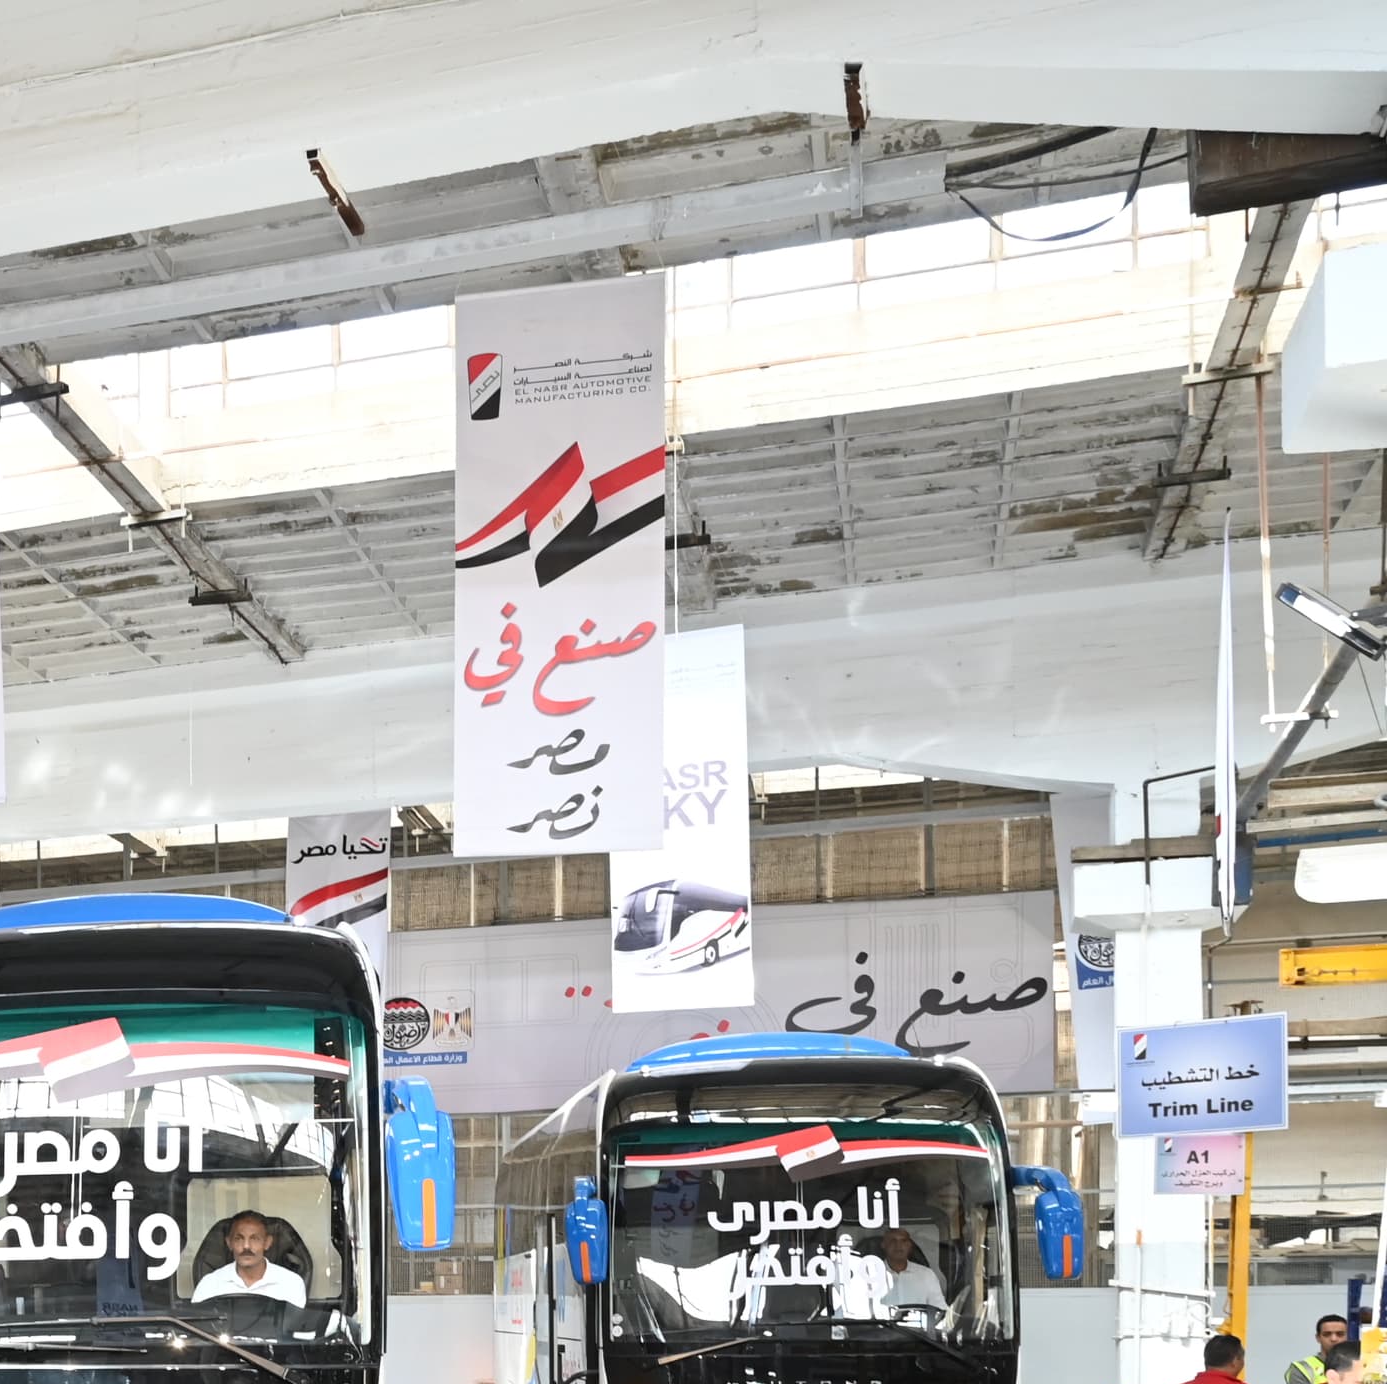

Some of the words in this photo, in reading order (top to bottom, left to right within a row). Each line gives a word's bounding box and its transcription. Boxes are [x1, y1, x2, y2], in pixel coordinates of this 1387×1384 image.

[513, 358, 572, 374] النصر
[575, 350, 653, 365] شركة
[513, 373, 572, 388] السيارات
[575, 364, 653, 380] لصناعة
[515, 387, 529, 397] EL
[534, 383, 568, 395] NASR
[573, 375, 652, 391] AUTOMOTIVE
[515, 387, 624, 406] MANUFACTURING
[629, 384, 652, 394] CO.
[532, 617, 657, 717] صنع
[506, 727, 611, 776] مصر
[664, 759, 729, 792] ASR
[506, 784, 605, 841] نصر
[663, 788, 728, 831] KY
[290, 844, 337, 864] مصر
[342, 833, 389, 860] تحيا
[897, 968, 1048, 1054] صنع
[1140, 1066, 1220, 1090] التشطيب
[1224, 1063, 1260, 1081] خط
[1148, 1102, 1198, 1119] Trim
[1206, 1097, 1254, 1115] Line
[1186, 1149, 1210, 1165] A1
[857, 1178, 901, 1229] أنا
